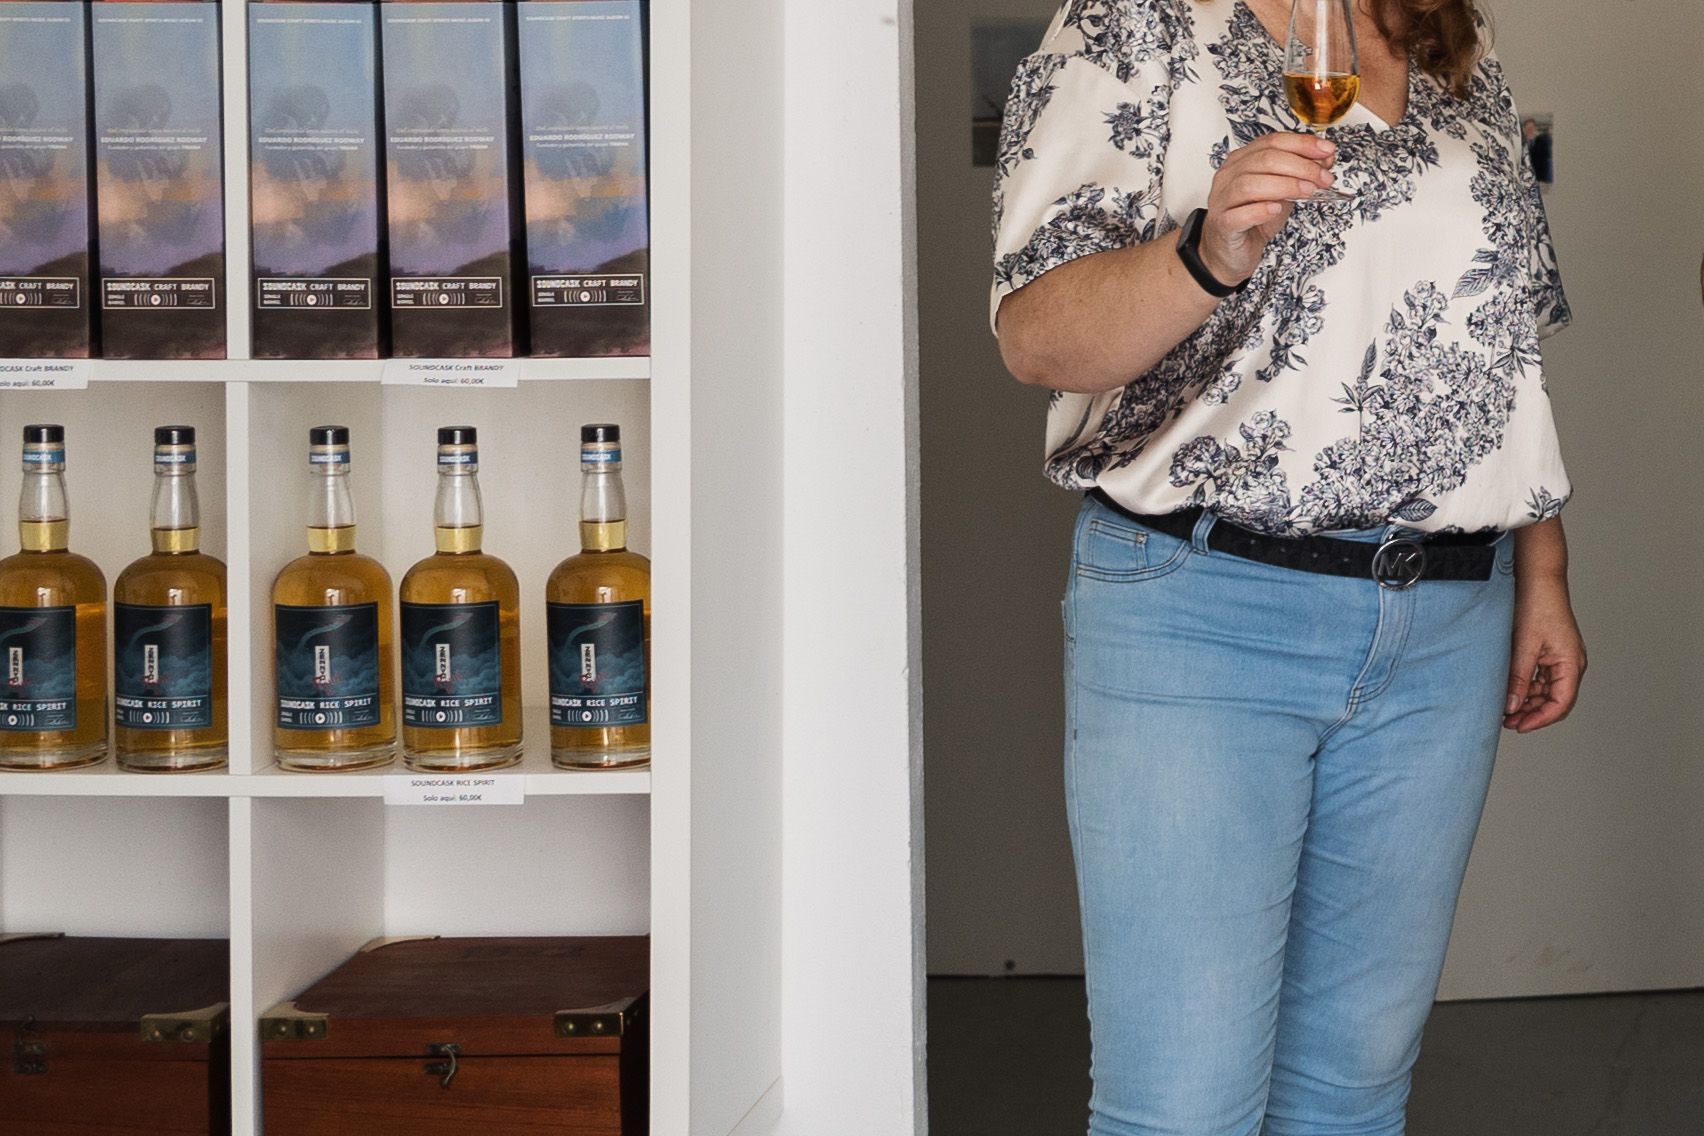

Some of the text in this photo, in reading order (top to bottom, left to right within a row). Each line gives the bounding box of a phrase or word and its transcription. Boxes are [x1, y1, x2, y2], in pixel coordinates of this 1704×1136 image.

[19, 282, 74, 290] CRAFT BRANDY
[153, 283, 177, 291] CRAFT
[181, 283, 209, 291] BRANDY
[310, 283, 334, 291] CRAFT
[337, 283, 365, 291] BRANDY
[442, 282, 465, 290] CRAFT
[469, 282, 496, 290] BRANDY
[583, 280, 606, 288] CRAFT
[610, 279, 638, 288] BRANDY
[171, 699, 202, 708] SPIRIT
[319, 701, 340, 709] RICE
[344, 697, 371, 707] SPIRIT
[464, 696, 493, 706] SPIRIT
[586, 699, 605, 707] RICE
[609, 695, 638, 706] SPIRIT
[13, 702, 67, 711] RICE SPIRIT
[411, 779, 454, 787] SOUNDCASK
[423, 794, 438, 802] Solo
